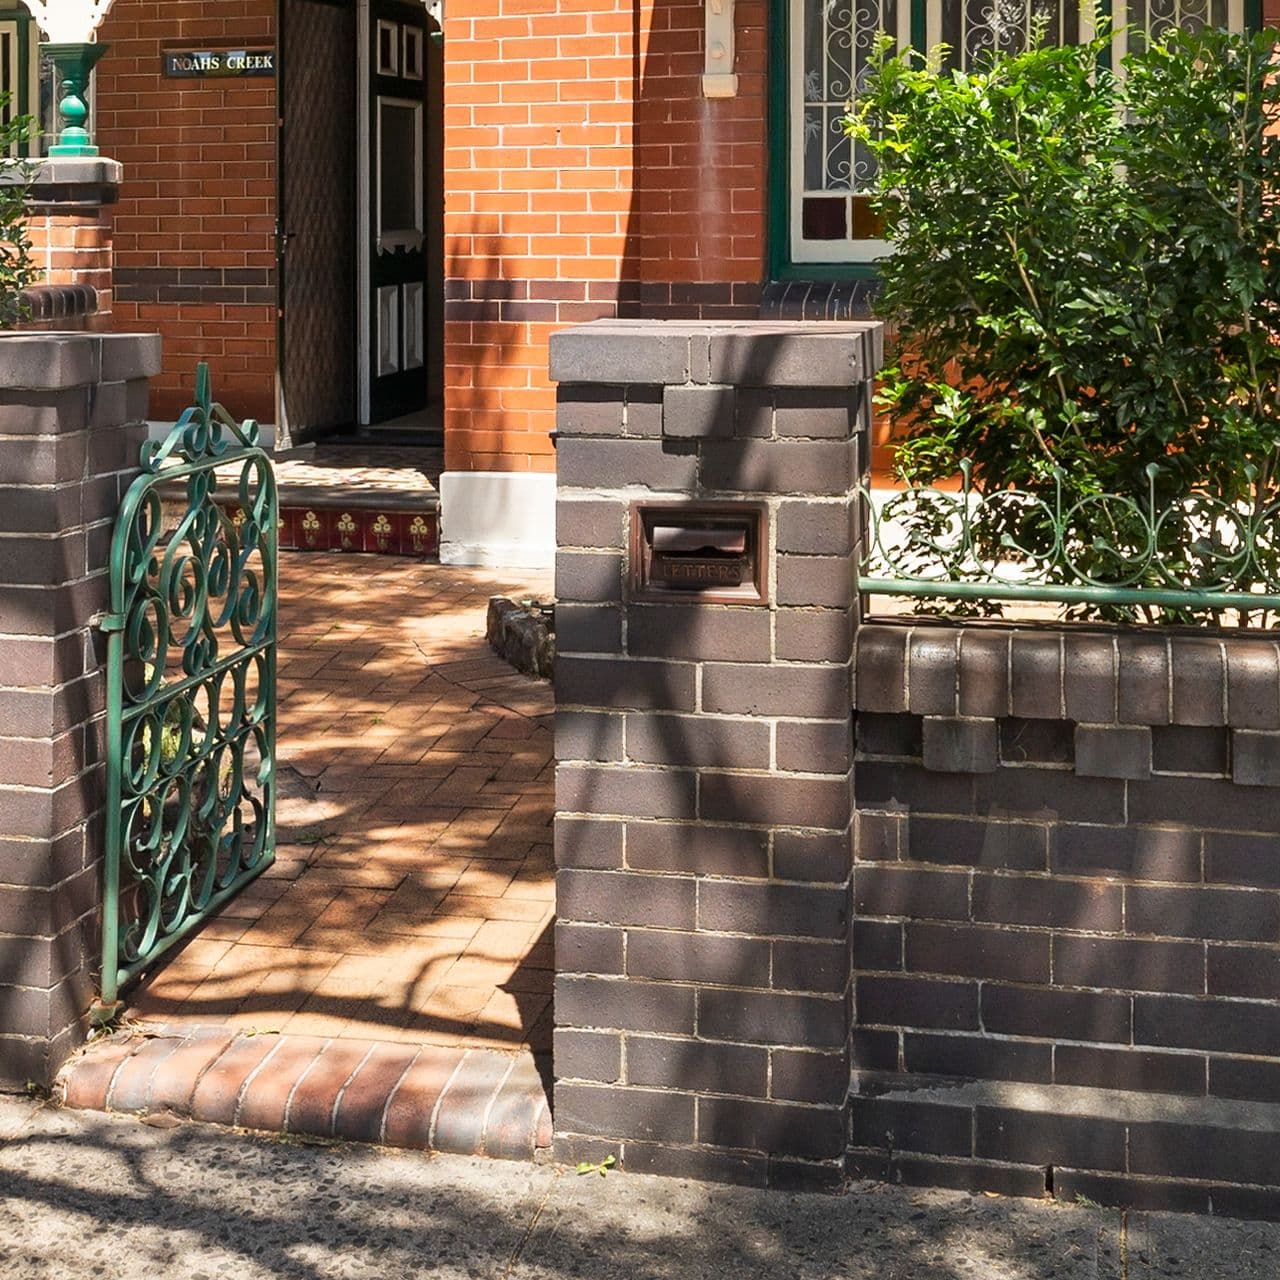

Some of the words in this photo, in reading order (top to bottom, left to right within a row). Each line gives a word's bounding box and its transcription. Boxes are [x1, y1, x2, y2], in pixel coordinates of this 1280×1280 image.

[172, 57, 220, 71] NOAHS
[226, 55, 273, 69] CREEK
[663, 564, 740, 577] LETTERS
